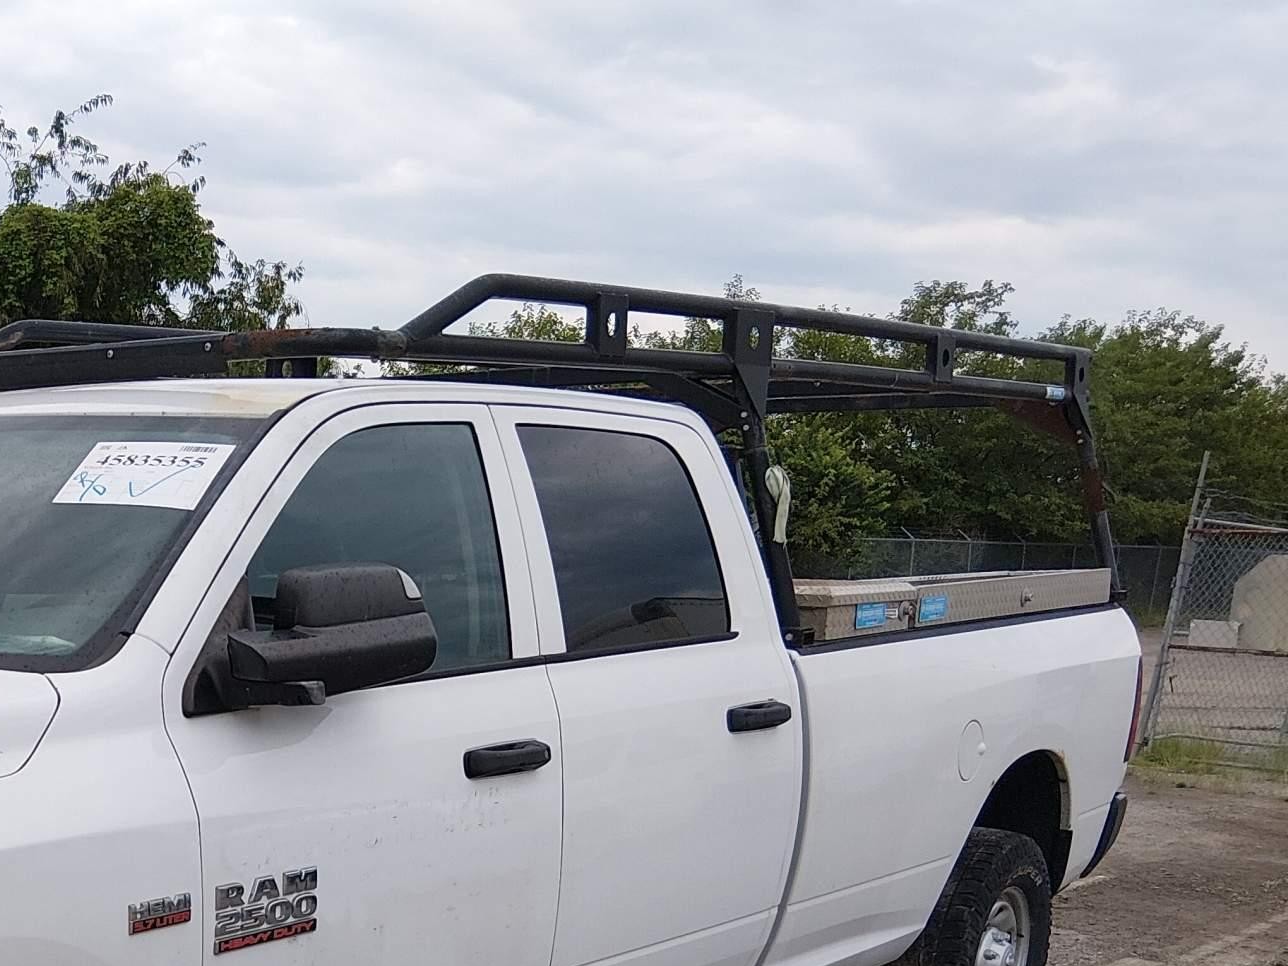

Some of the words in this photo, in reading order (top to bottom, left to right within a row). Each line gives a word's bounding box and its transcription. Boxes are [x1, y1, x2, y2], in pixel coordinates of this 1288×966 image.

[96, 453, 209, 468] 45835355
[215, 866, 318, 911] RAM
[128, 892, 192, 921] HEMI
[133, 919, 156, 934] 5.7
[156, 910, 191, 928] LITER
[215, 892, 318, 937] 2500
[220, 930, 271, 953] HEAVY
[273, 920, 315, 940] DUTY
